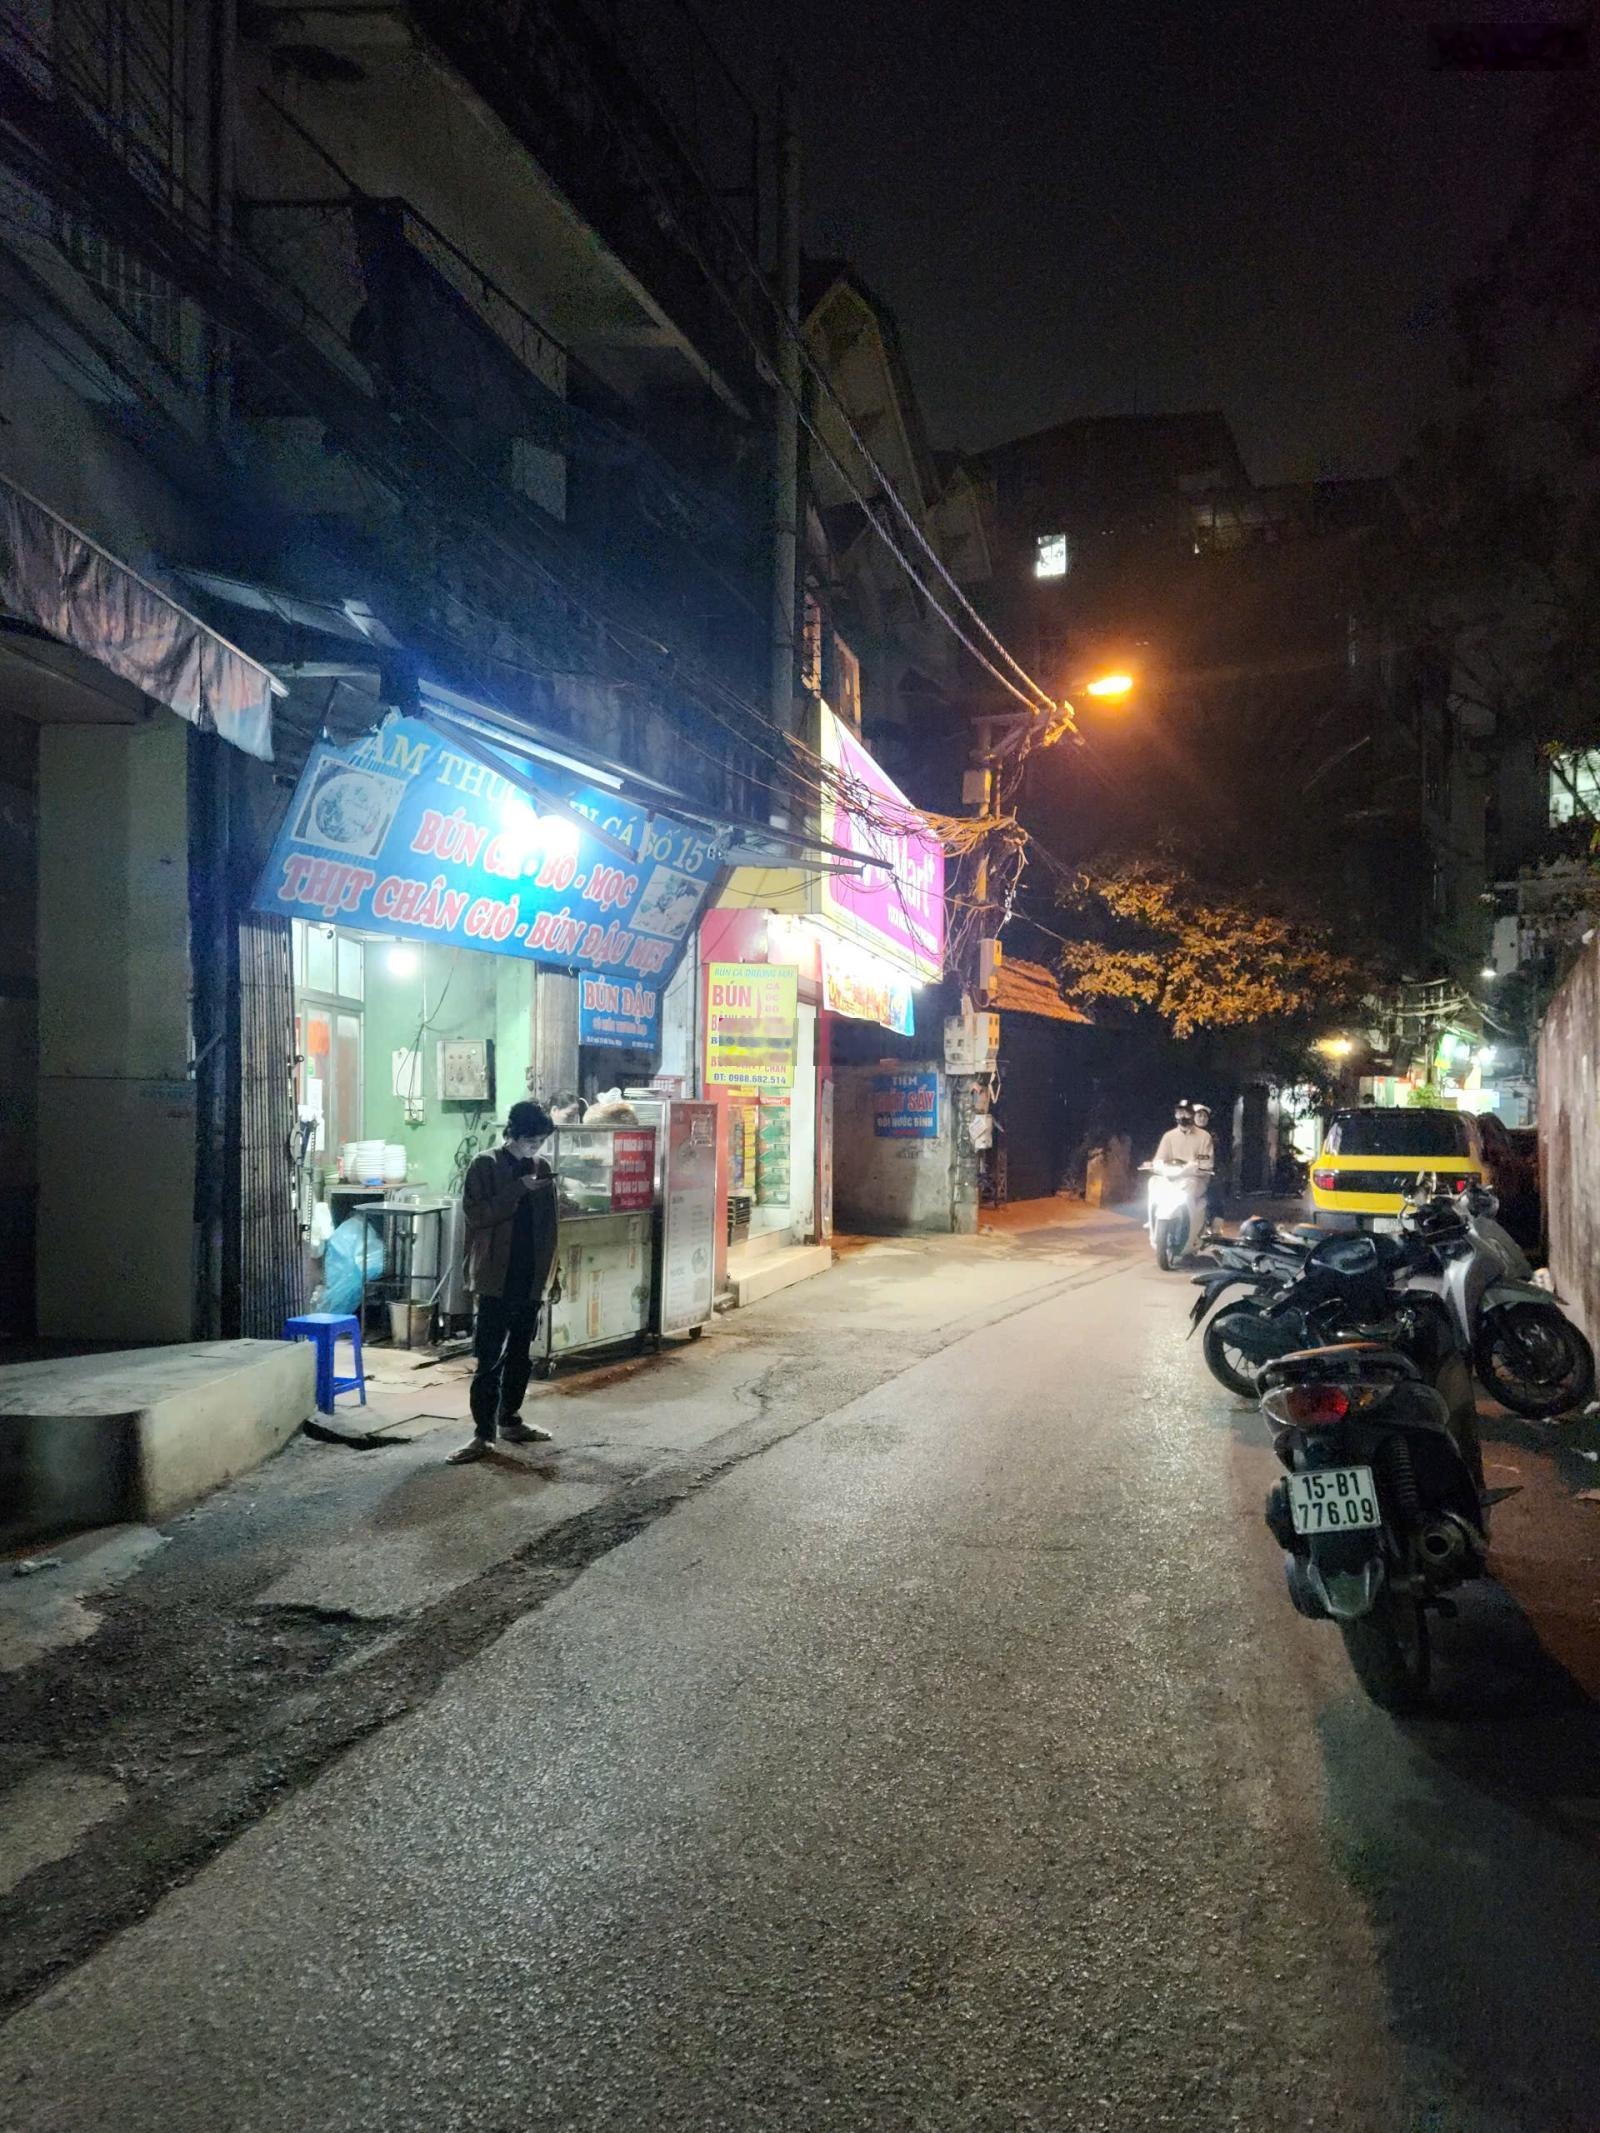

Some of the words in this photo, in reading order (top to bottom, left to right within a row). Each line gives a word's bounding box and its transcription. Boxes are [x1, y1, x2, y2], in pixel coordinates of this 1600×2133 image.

[411, 807, 489, 867] BÚN
[583, 864, 639, 912] MỌC
[278, 853, 376, 917] THỊT
[372, 874, 469, 932] CHÂN
[524, 906, 588, 955] BÚN
[577, 919, 634, 968] ĐẬU
[583, 974, 619, 1014] BÚN
[622, 981, 656, 1025] ĐẬU
[711, 980, 752, 1007] BÚN
[907, 1083, 935, 1113] SẤY
[1302, 1471, 1361, 1500] 15-B1
[1298, 1498, 1374, 1529] 776.09
